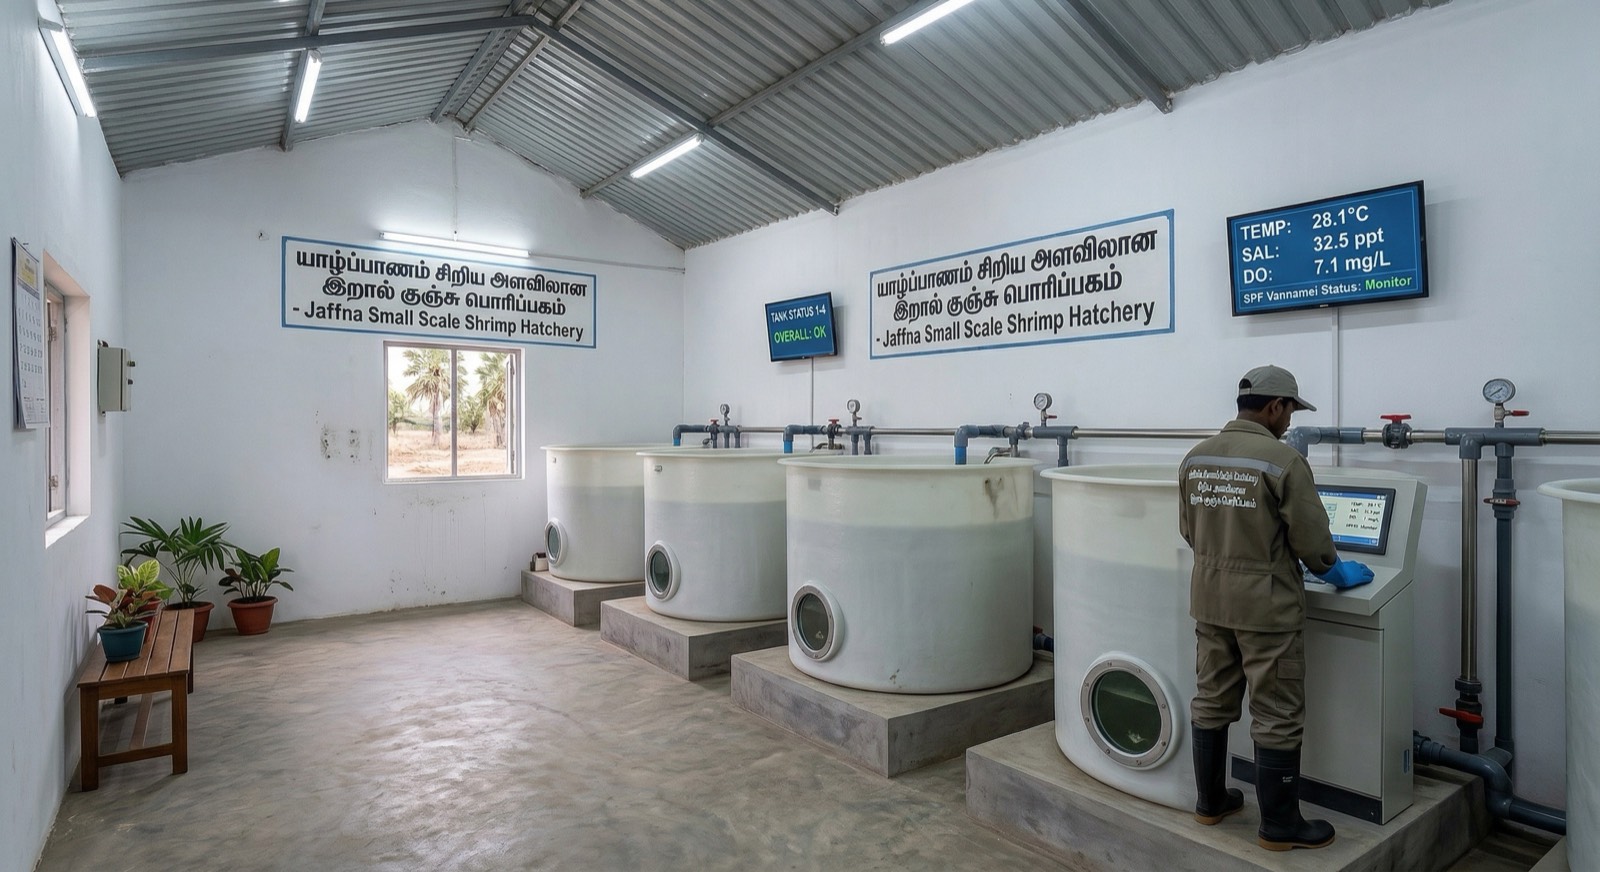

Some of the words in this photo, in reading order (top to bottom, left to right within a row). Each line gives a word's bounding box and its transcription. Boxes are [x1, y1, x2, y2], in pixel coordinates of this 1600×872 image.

[1240, 219, 1291, 241] TEMP:
[1312, 205, 1369, 230] 28.1°C
[1242, 245, 1279, 262] SAL:
[1313, 232, 1349, 252] 32.5
[1354, 227, 1384, 249] ppt
[296, 249, 430, 279] யாழ்ப்பாணம்
[435, 263, 485, 287] சிறிய
[490, 272, 587, 297] அளவிலான
[877, 260, 972, 299] யாழ்ப்பாணம்
[977, 252, 1025, 284] சிறிய
[1031, 229, 1157, 271] அளவிலான
[1243, 267, 1272, 285] DO:
[1314, 257, 1338, 275] 7.1
[1345, 250, 1391, 273] mg/L
[322, 276, 395, 301] இறால்
[401, 284, 460, 308] குஞ்சு
[466, 292, 566, 316] பொரிப்பகம்
[894, 292, 942, 324] இறால்
[947, 286, 998, 316] குஞ்சு
[1004, 263, 1122, 305] பொரிப்பகம்
[1243, 291, 1263, 304] SPF
[1267, 286, 1318, 301] Vannamei
[1321, 282, 1361, 295] Status:
[1365, 276, 1412, 291] Monitor
[304, 301, 362, 322] Jaffna
[368, 306, 413, 325] Small
[419, 310, 460, 329] Scale
[465, 314, 516, 336] Shrimp
[521, 319, 584, 342] Hatchery
[771, 310, 788, 323] TANK
[788, 305, 814, 320] STATUS
[815, 304, 826, 315] 1-4
[883, 327, 920, 347] Jaffna
[925, 321, 960, 343] Small
[964, 316, 1002, 338] Scale
[1007, 311, 1064, 334] Shrimp
[1069, 300, 1155, 326] Hatchery
[774, 328, 812, 344] OVERALL:
[814, 325, 826, 339] OK
